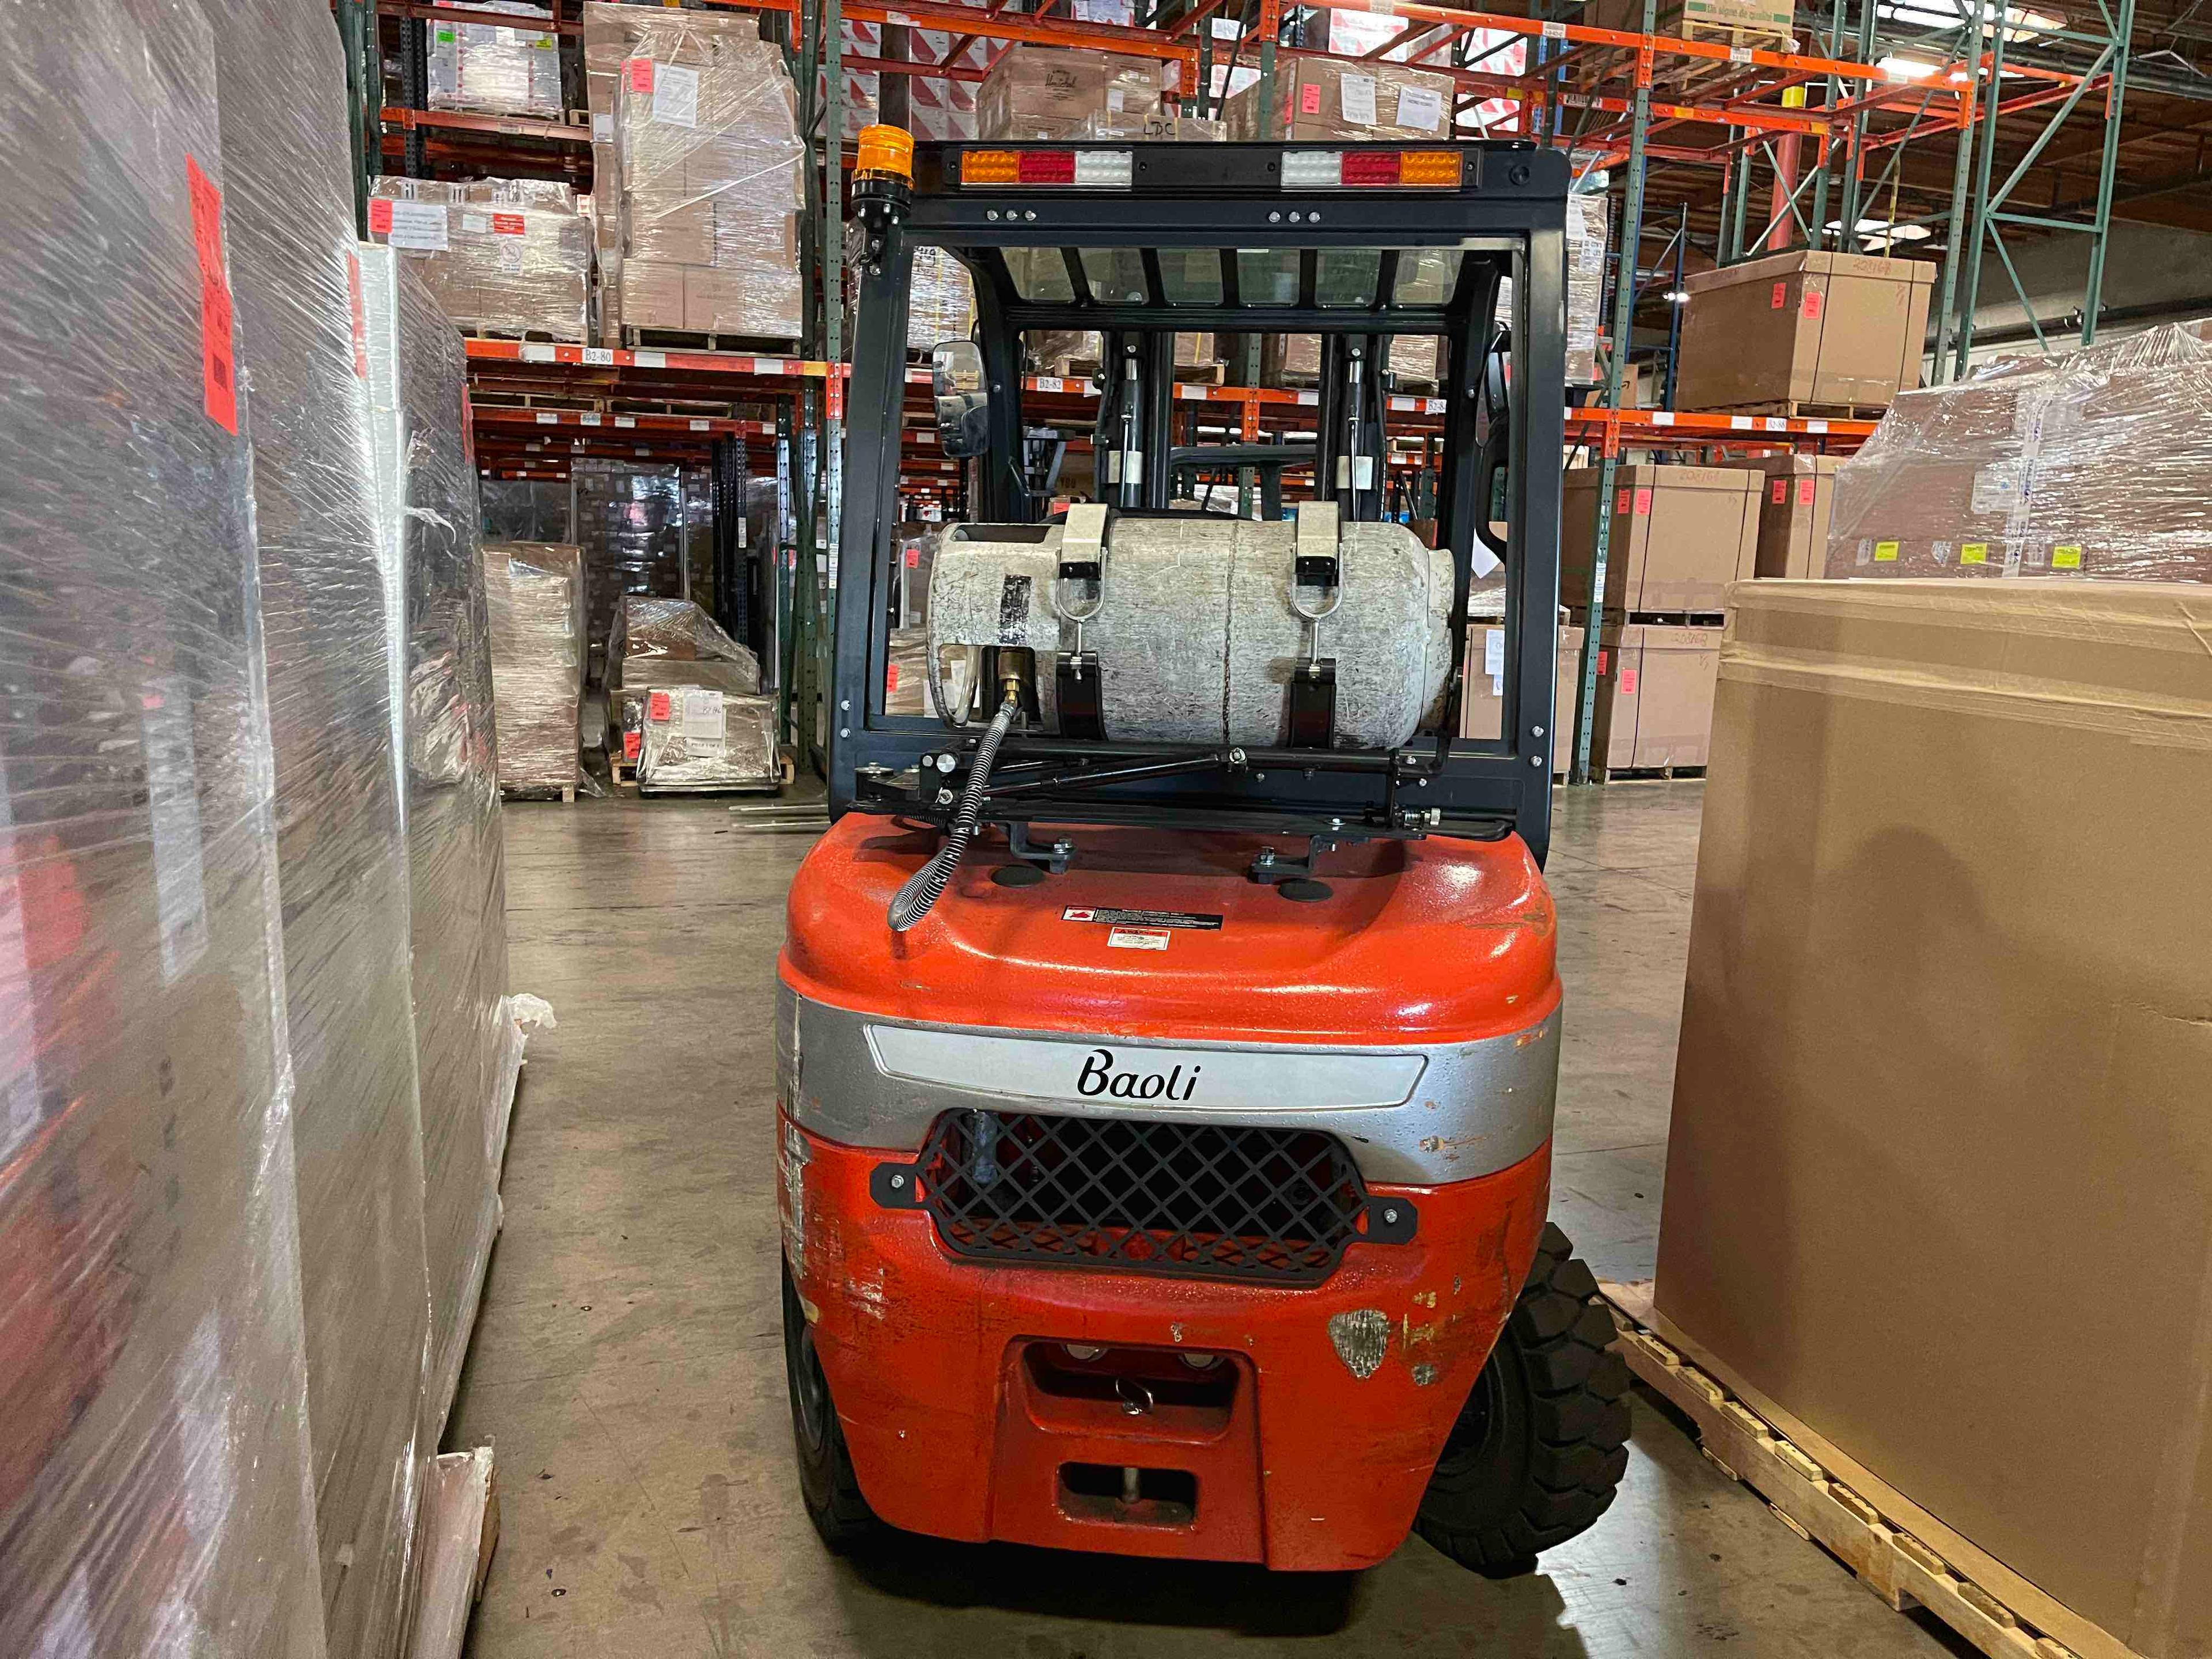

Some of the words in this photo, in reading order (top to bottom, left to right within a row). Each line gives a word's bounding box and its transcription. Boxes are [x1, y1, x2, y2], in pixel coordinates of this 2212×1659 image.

[585, 349, 611, 362] B2-80
[1039, 377, 1061, 389] B2-82
[1428, 400, 1446, 411] B2-8
[1077, 1048, 1201, 1101] Baoli
